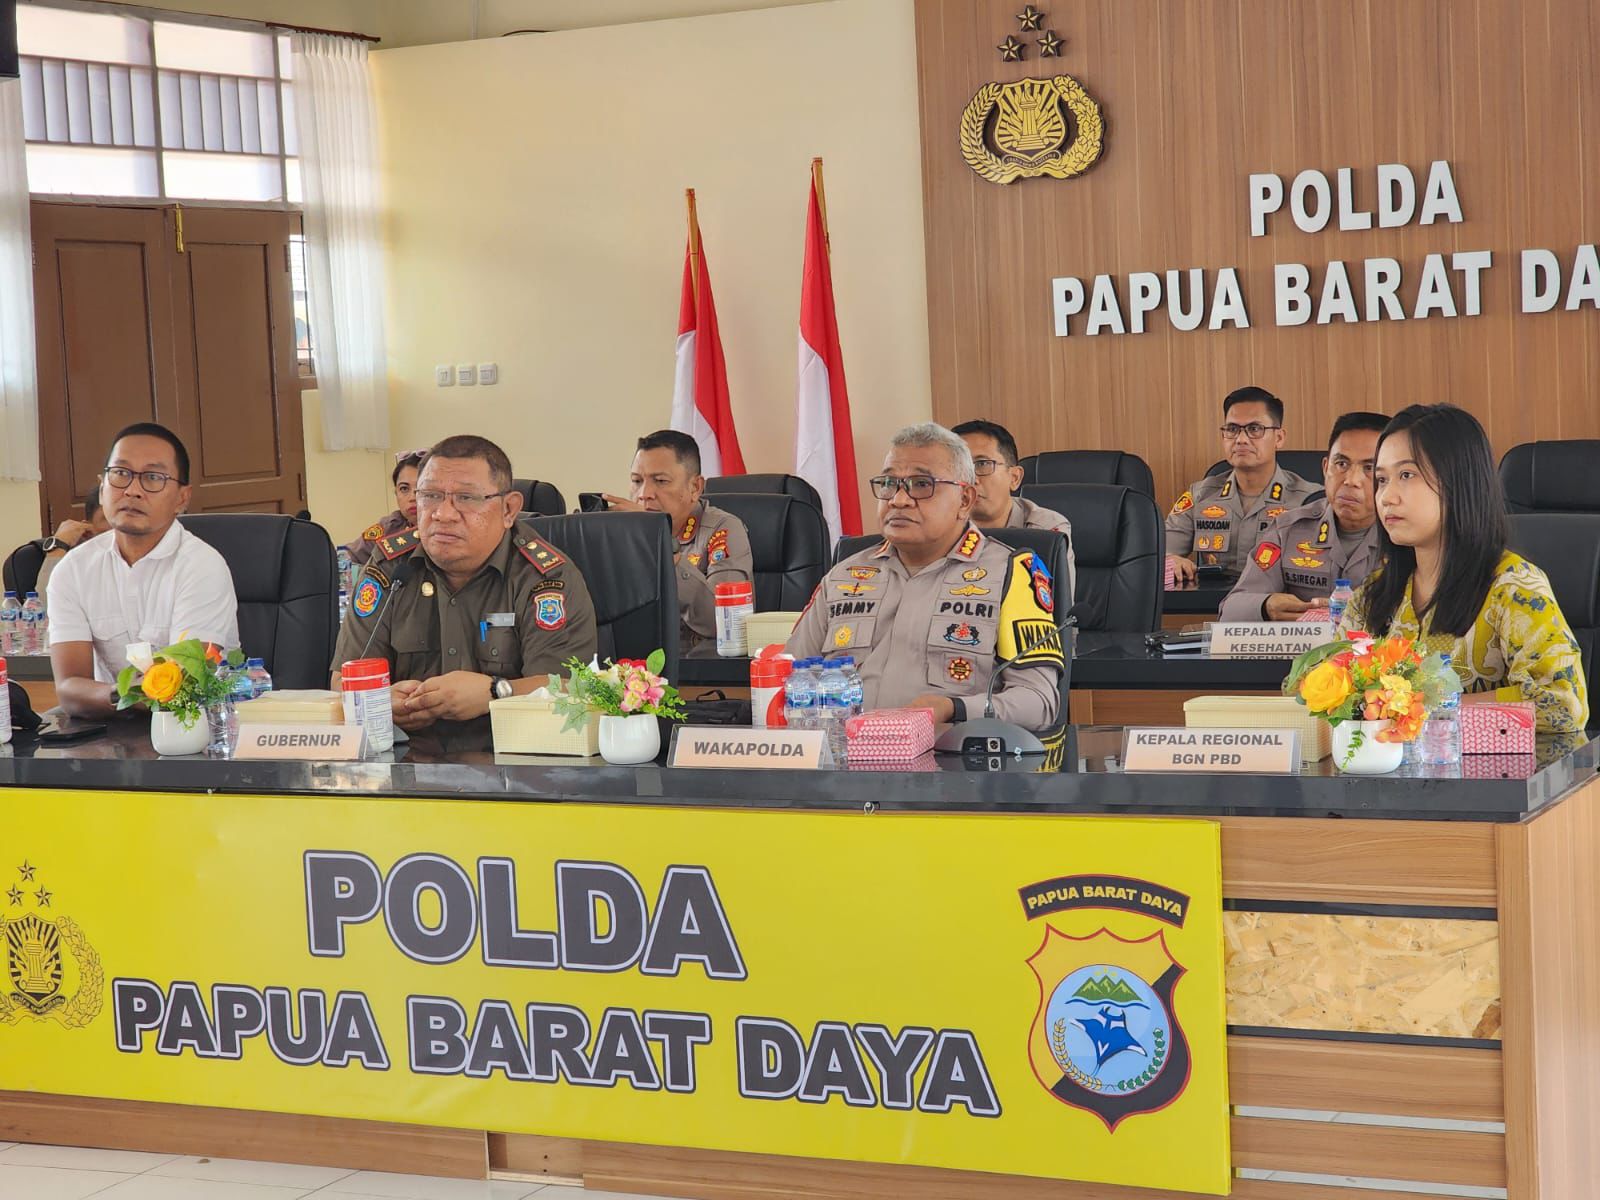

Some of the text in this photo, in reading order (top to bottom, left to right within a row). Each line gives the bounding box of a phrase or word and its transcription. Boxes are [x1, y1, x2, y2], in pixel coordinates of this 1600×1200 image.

[1248, 160, 1464, 237] POLDA
[1051, 244, 1600, 337] PAPUA BARAT DA
[940, 601, 994, 618] POLRI
[1224, 627, 1322, 637] KEPALA DINAS
[1230, 643, 1312, 652] KESEHATAN
[256, 734, 341, 747] GUBERNUR
[1136, 734, 1283, 746] KEPALA REGIONAL
[694, 741, 804, 757] WAKAPOLDA
[1172, 753, 1242, 765] BGN PBD
[1027, 885, 1182, 917] PAPUA BARAT DAYA
[303, 849, 748, 982] POLDA
[112, 977, 1002, 1119] PAPUA BARAT DAYA
